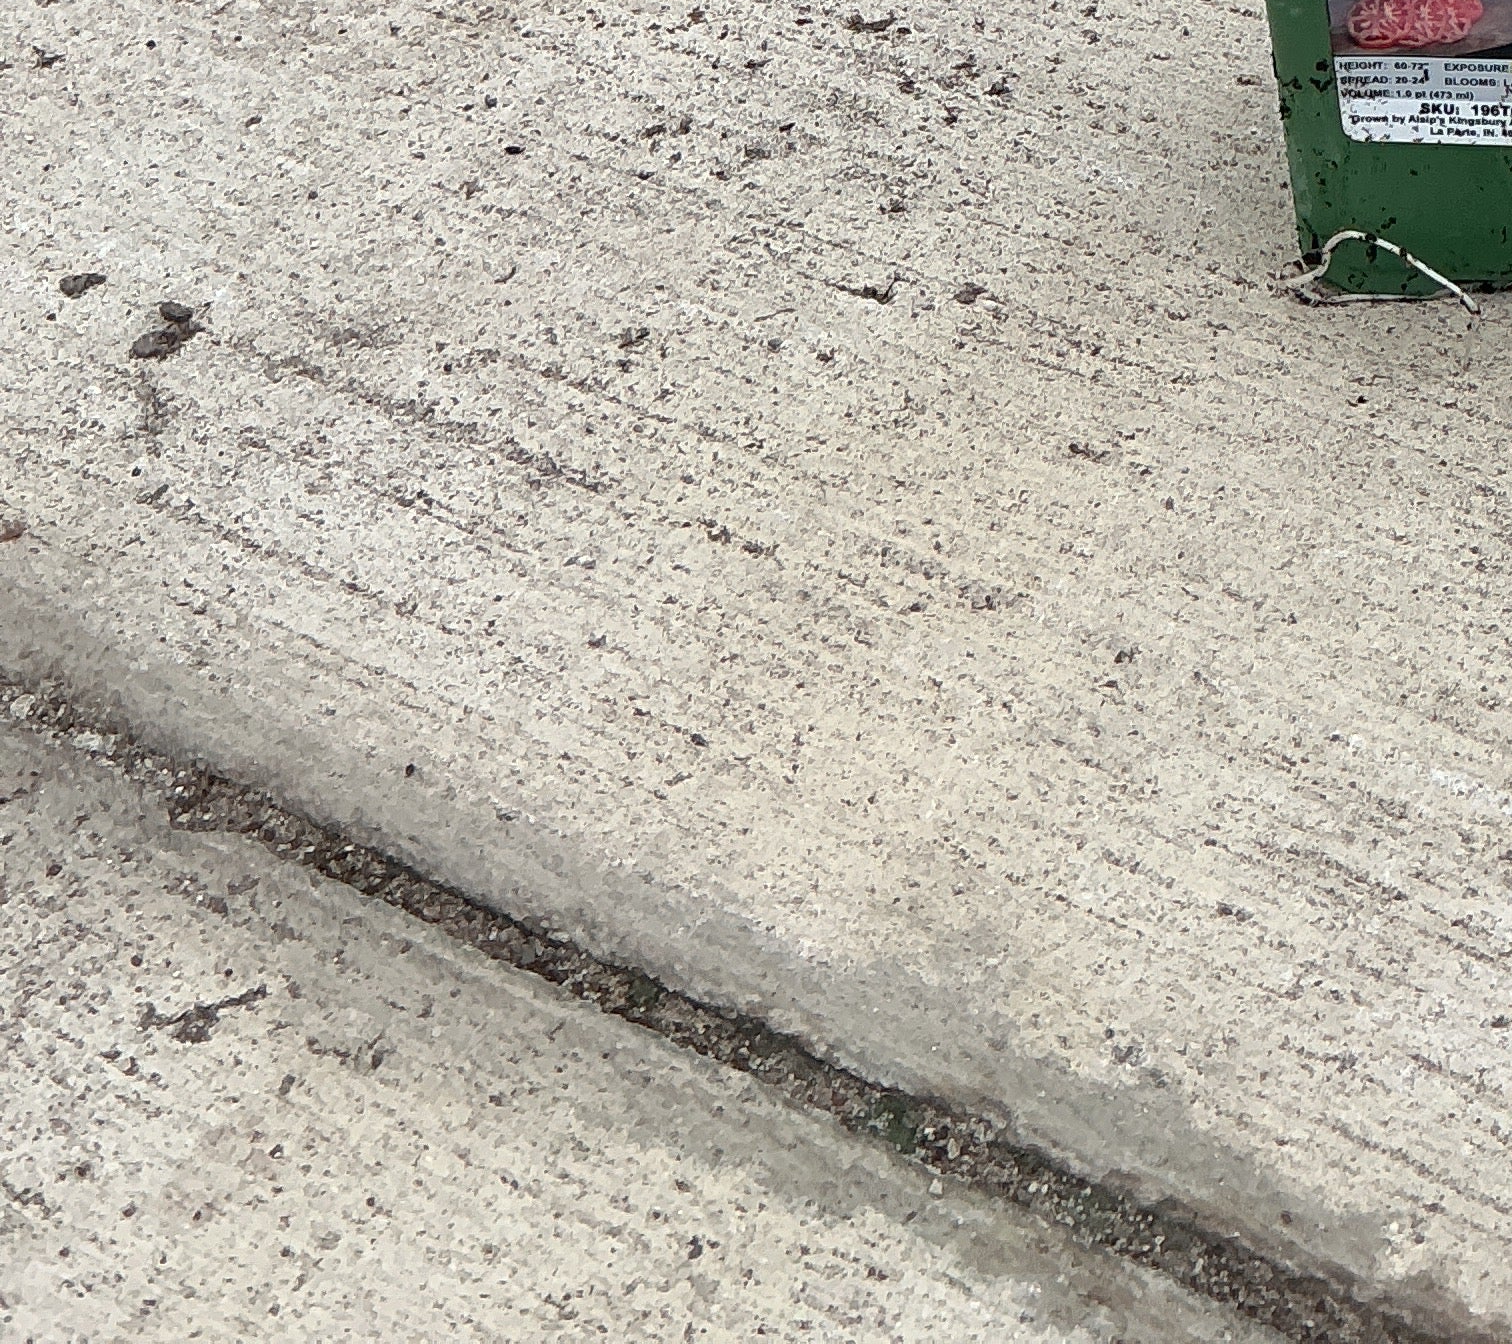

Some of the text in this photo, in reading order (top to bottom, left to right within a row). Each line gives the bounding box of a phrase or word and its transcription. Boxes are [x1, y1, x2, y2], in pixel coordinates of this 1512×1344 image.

[1339, 61, 1388, 71] HEIGHT:
[1444, 63, 1512, 73] EXPOSURE:
[1340, 75, 1392, 85] SPREAD:
[1444, 77, 1500, 87] BLOOMS:
[1395, 90, 1412, 98] 1.0
[1429, 90, 1453, 100] (473
[1455, 91, 1474, 101] ml)
[1420, 103, 1460, 115] SKU:
[1350, 115, 1388, 124] Grown
[1392, 114, 1405, 124] by
[1448, 116, 1506, 127] Kingsbury
[1430, 127, 1444, 135] La
